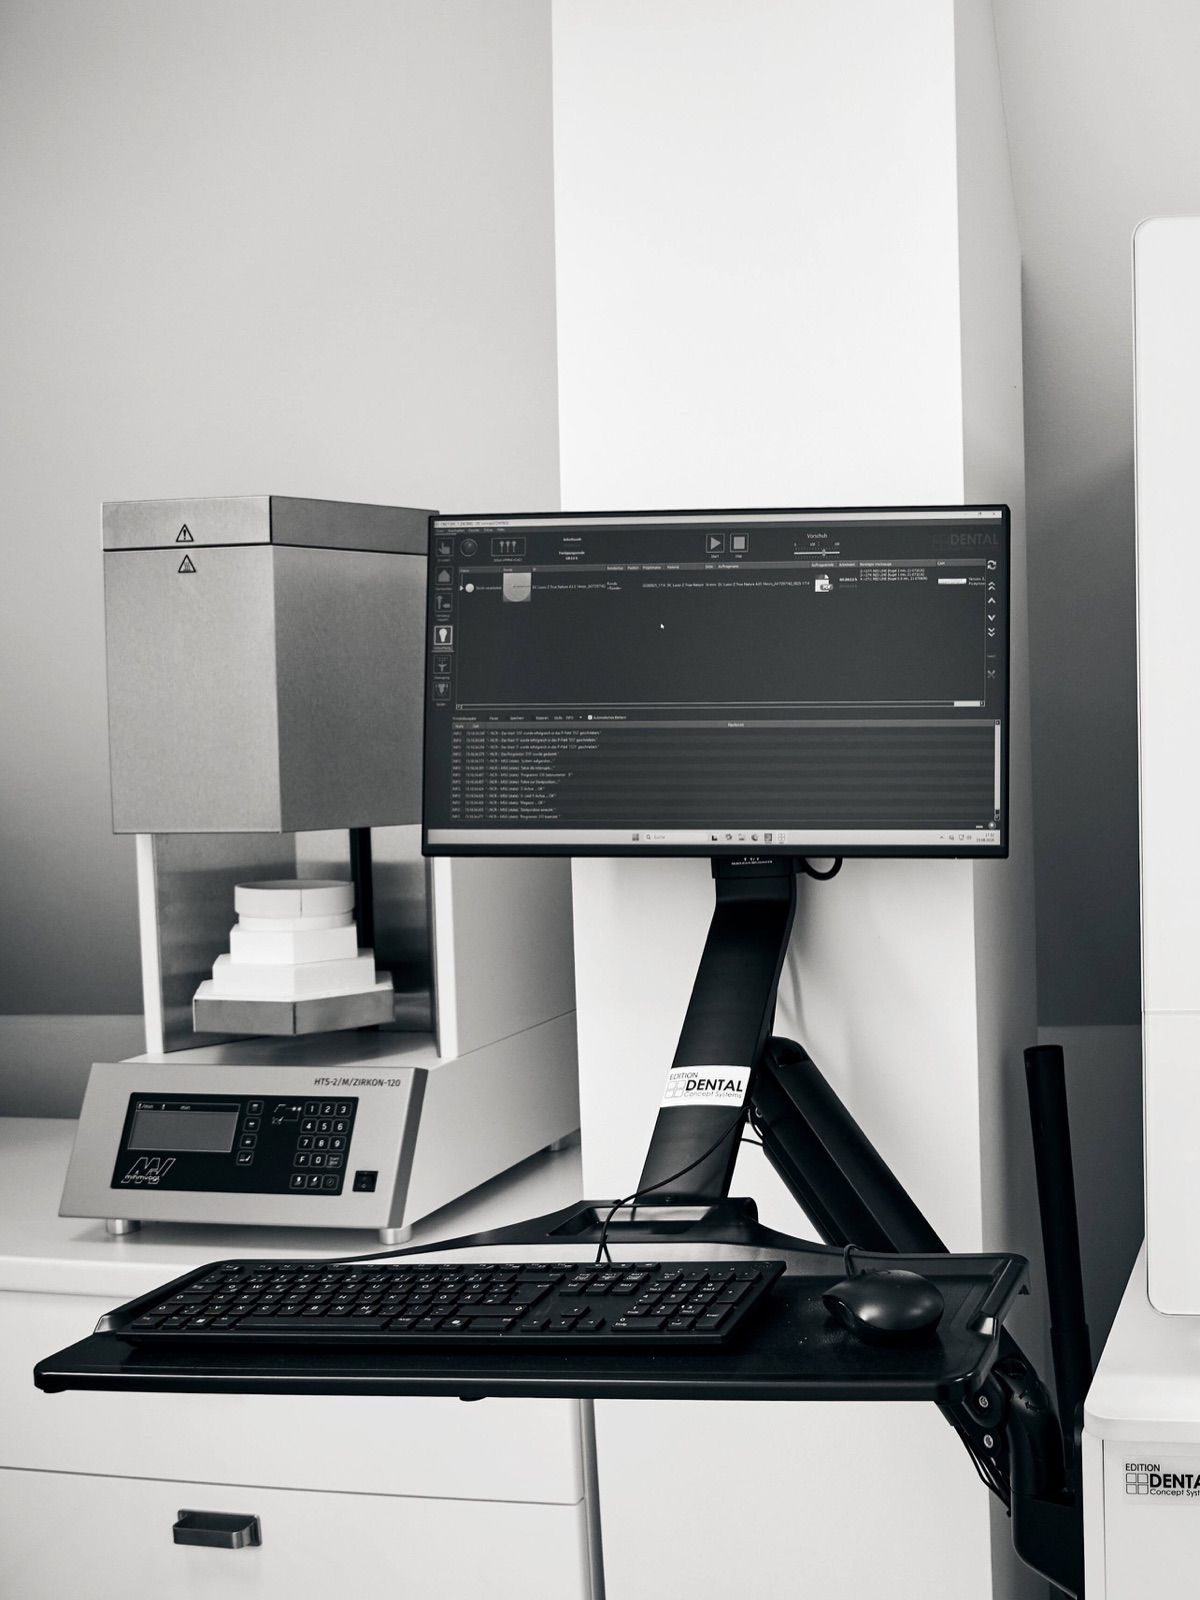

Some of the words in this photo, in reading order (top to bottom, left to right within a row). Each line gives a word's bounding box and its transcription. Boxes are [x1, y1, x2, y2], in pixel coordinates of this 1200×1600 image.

[950, 533, 999, 546] DENTAL
[669, 1071, 699, 1081] EDITION
[685, 1079, 744, 1093] DENTAL
[310, 1105, 315, 1113] 1
[324, 1105, 332, 1113] 2
[340, 1105, 347, 1113] 3
[306, 1122, 312, 1130] 4
[321, 1122, 328, 1130] 5
[337, 1122, 344, 1131] 6
[303, 1139, 309, 1147] 7
[318, 1139, 325, 1147] 8
[334, 1139, 341, 1148] 9
[1125, 1463, 1161, 1472] EDITION
[1149, 1488, 1184, 1497] Concept
